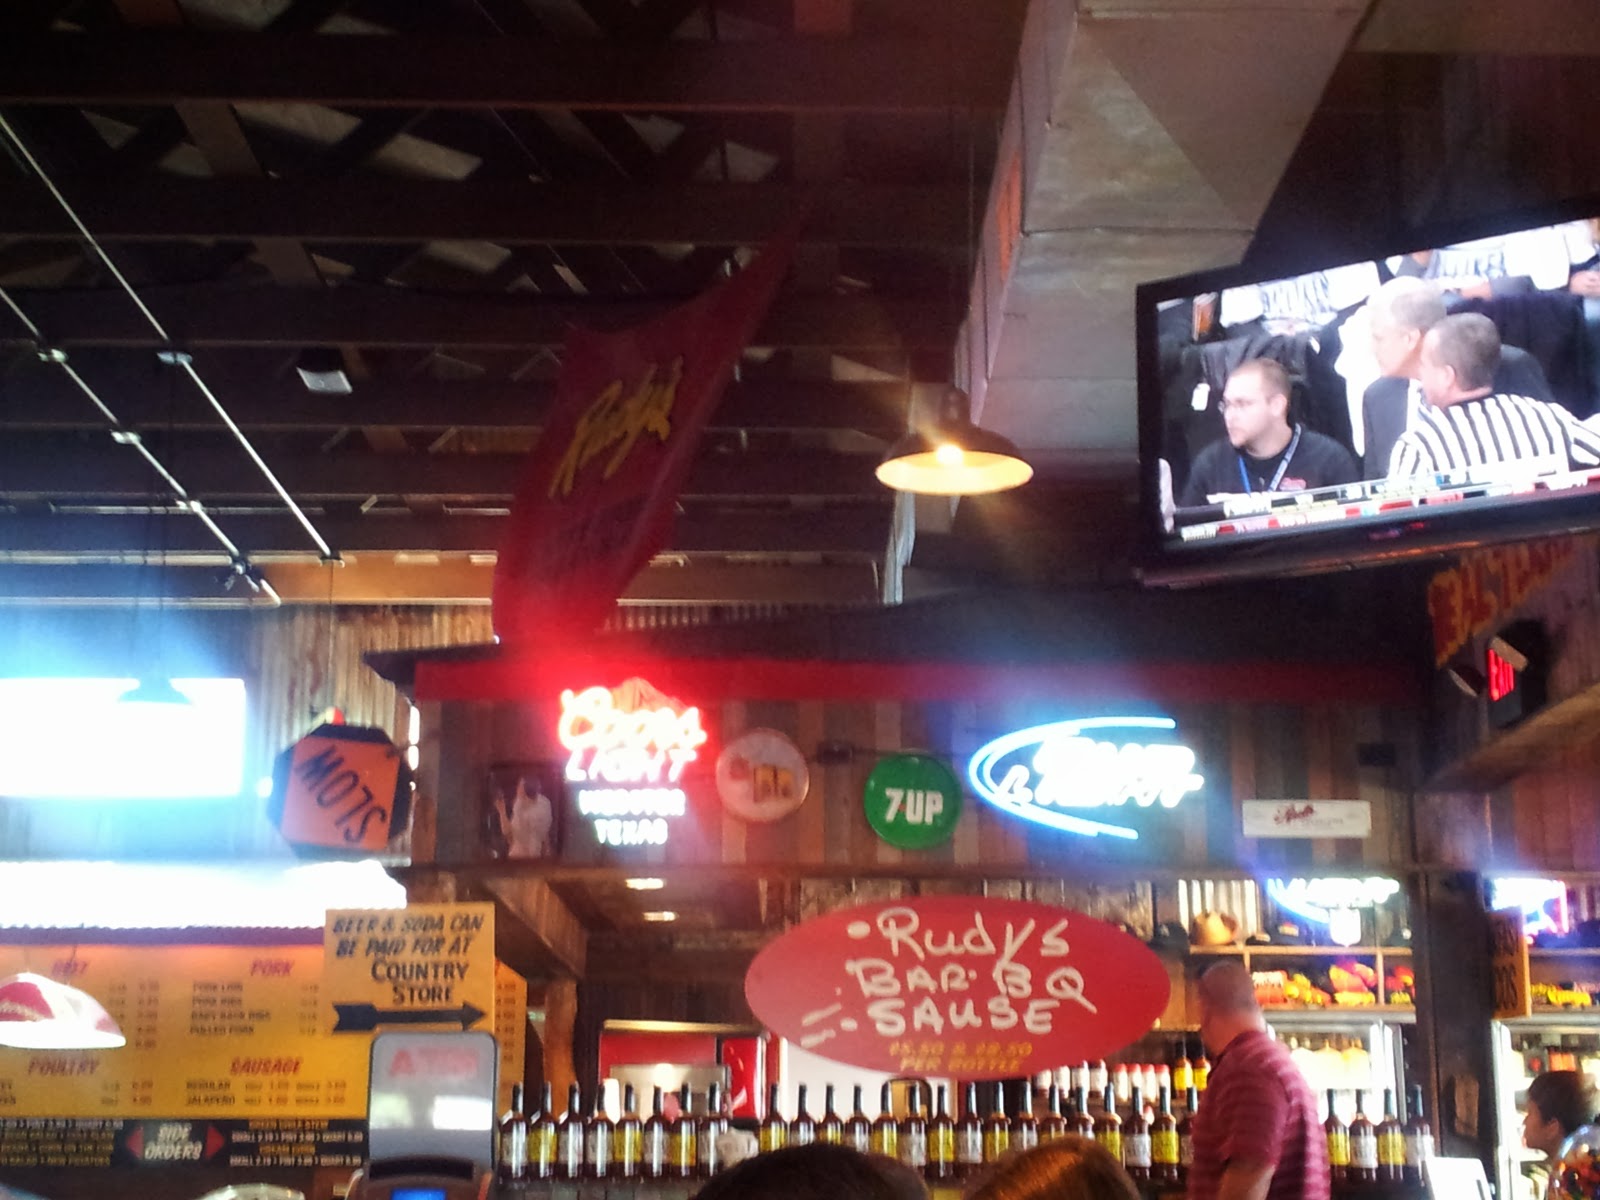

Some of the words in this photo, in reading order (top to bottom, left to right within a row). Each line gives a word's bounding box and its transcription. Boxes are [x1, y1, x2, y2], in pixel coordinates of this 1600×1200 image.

[566, 749, 697, 782] LIGHT
[885, 788, 944, 825] 7UP
[402, 914, 445, 932] SODA
[450, 913, 485, 931] CAN
[336, 939, 358, 957] BE
[365, 937, 406, 956] PAID
[413, 936, 446, 955] FOR
[448, 935, 474, 955] AT
[251, 959, 295, 977] PORK
[371, 961, 470, 981] COUNTRY
[393, 986, 453, 1004] STORE
[230, 1057, 302, 1075] SAUSAGE
[145, 1141, 202, 1161] ORDERS
